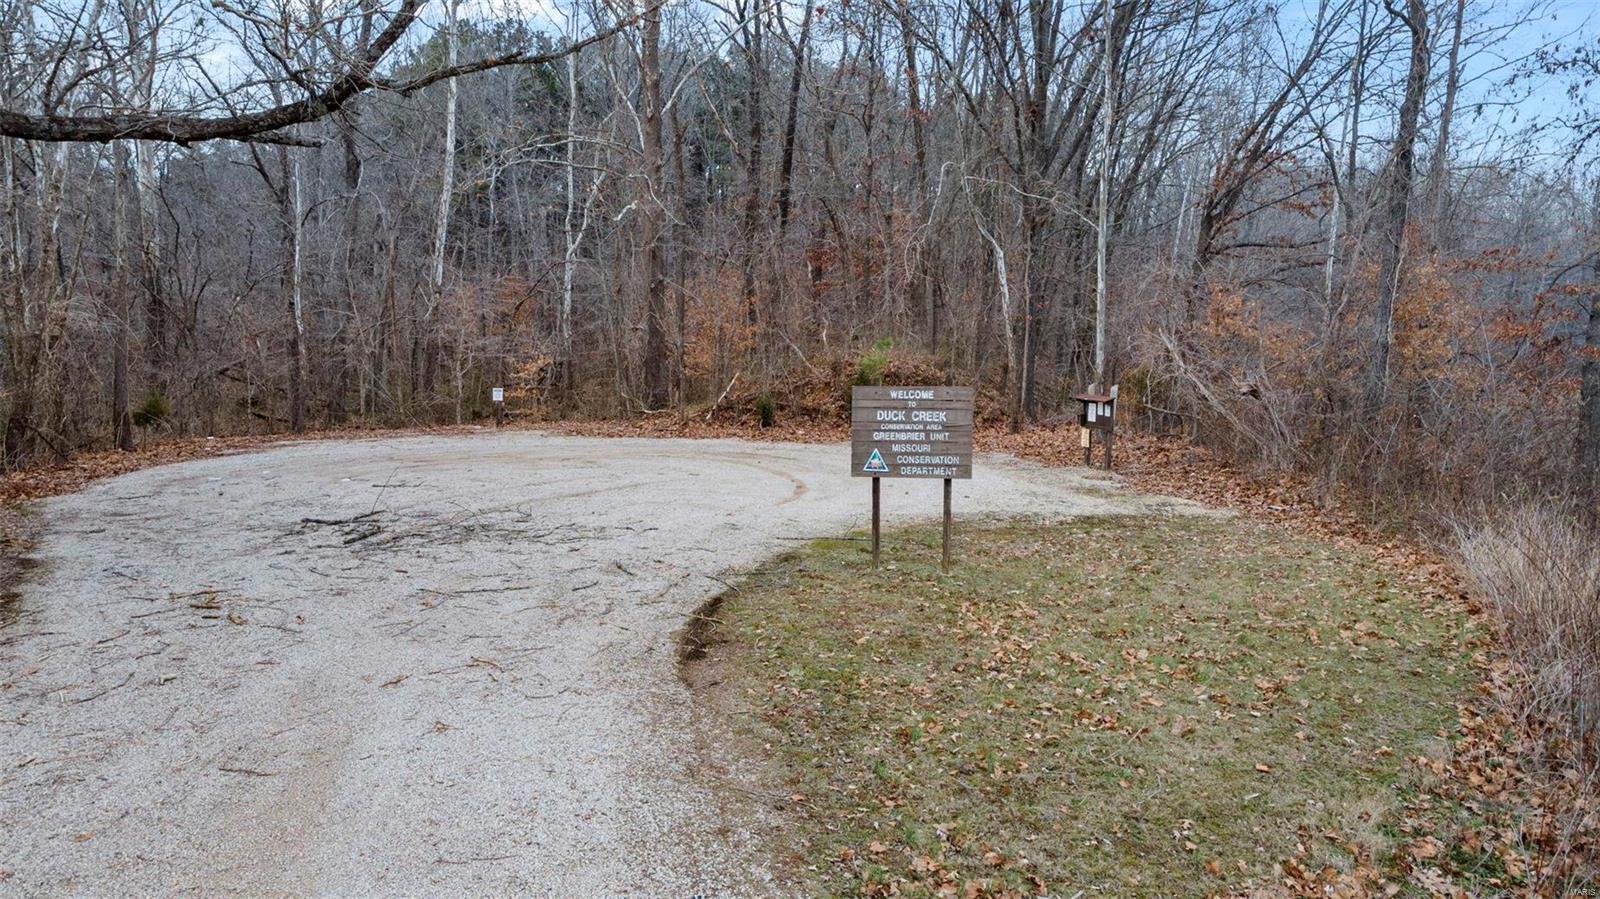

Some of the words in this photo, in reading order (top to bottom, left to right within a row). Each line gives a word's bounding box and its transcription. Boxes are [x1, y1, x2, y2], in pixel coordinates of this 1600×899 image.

[890, 390, 934, 399] WELCOME
[877, 410, 905, 420] DUCK
[912, 411, 946, 421] CREEK
[901, 467, 957, 475] DEPARTMENT
